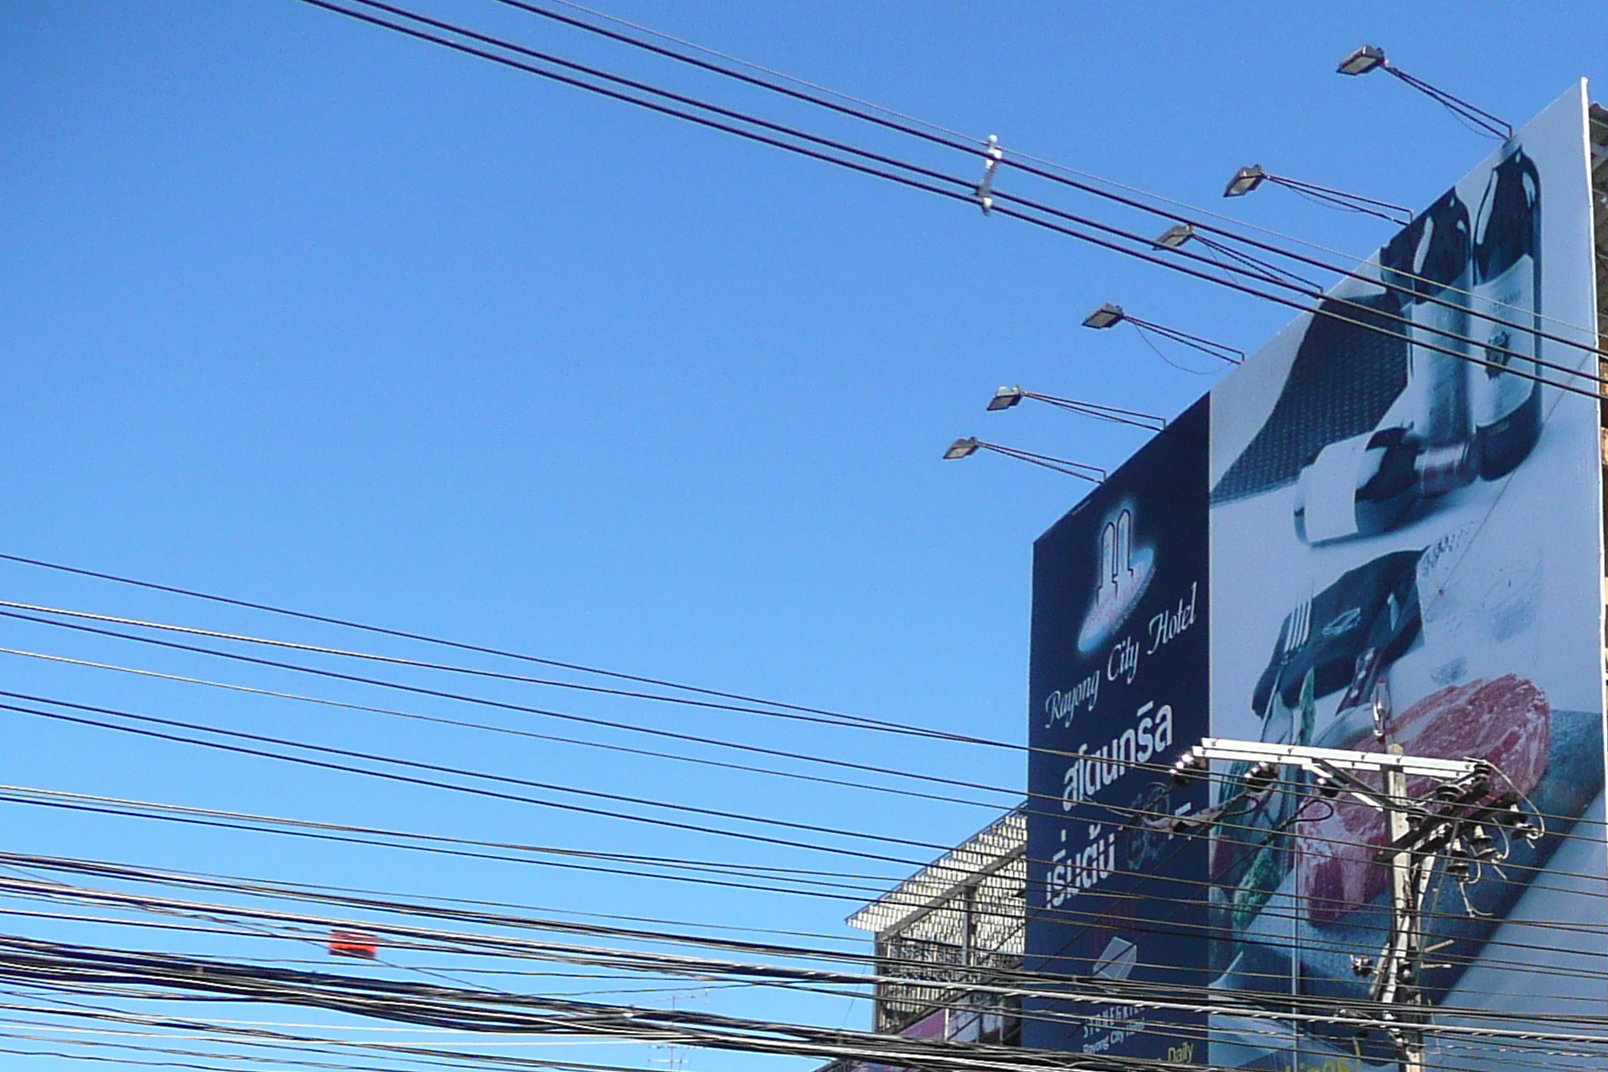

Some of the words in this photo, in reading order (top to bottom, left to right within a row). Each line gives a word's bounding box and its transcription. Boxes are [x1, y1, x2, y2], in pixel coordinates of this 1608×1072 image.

[1045, 670, 1100, 729] Rayong
[1107, 635, 1139, 685] City
[1147, 580, 1197, 655] Hotel
